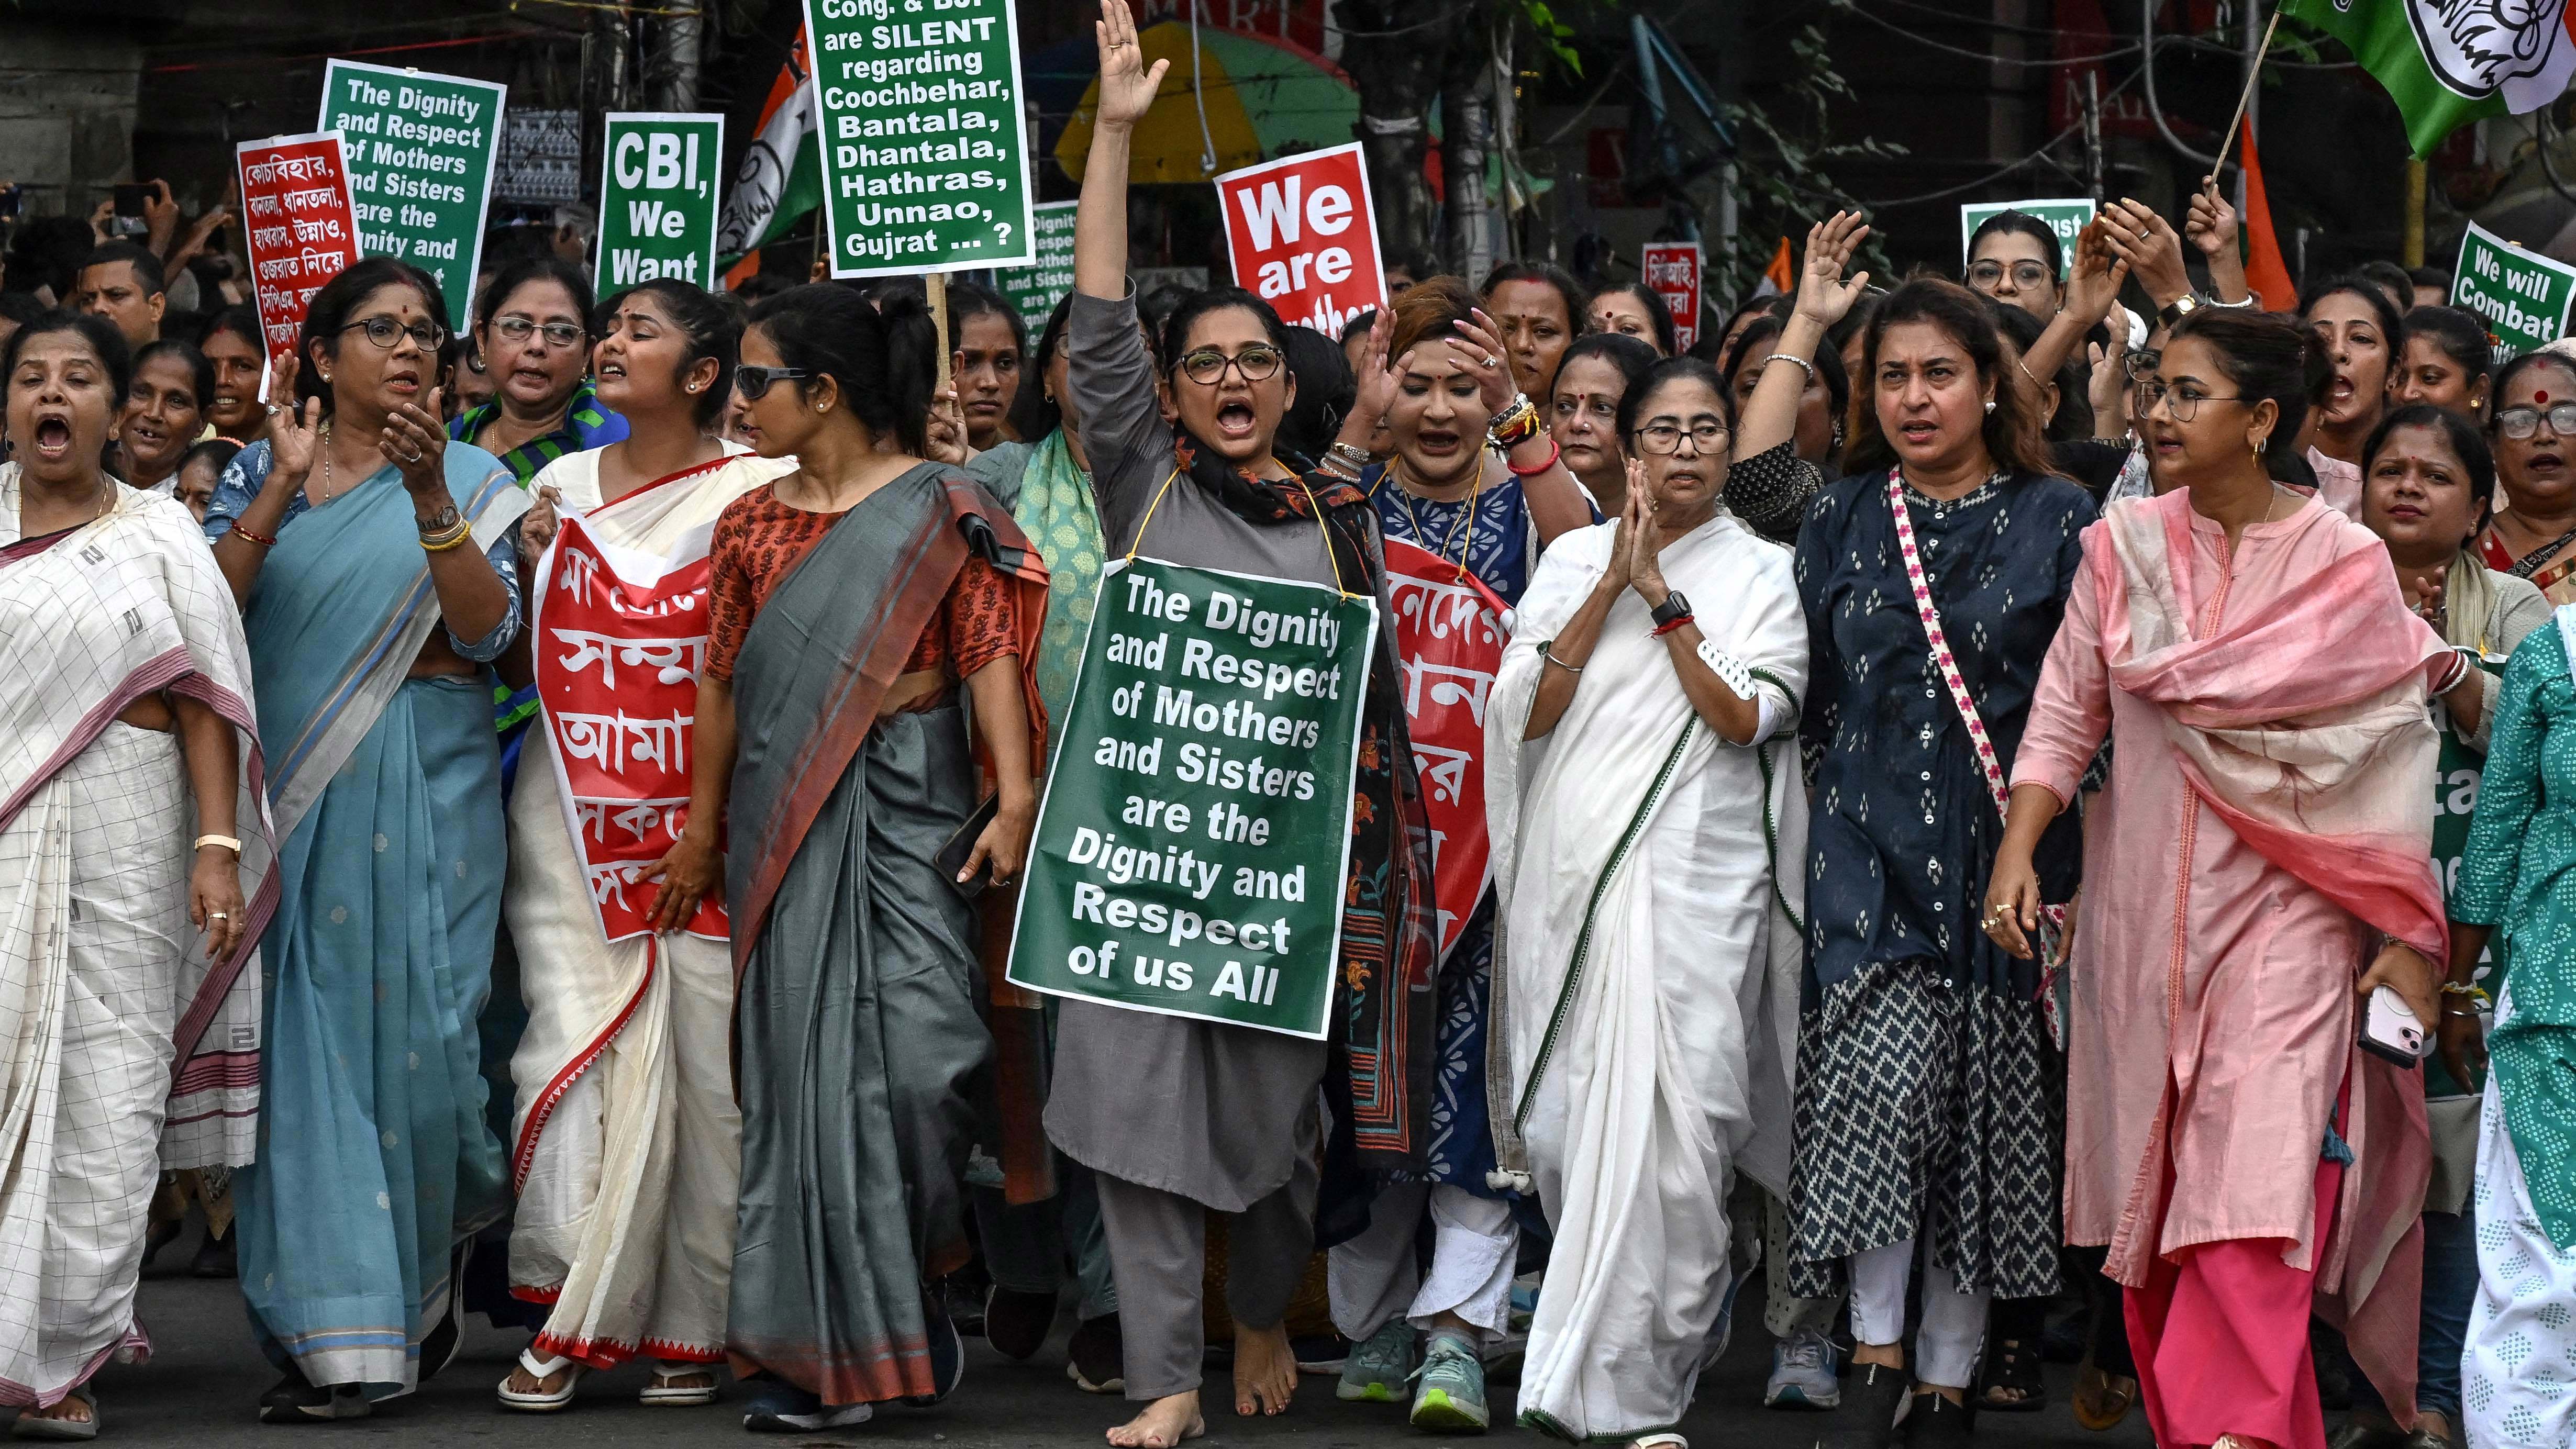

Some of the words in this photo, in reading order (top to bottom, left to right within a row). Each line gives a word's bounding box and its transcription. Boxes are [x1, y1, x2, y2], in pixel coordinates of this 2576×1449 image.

[822, 0, 895, 21] Cong.
[825, 31, 862, 51] are
[872, 17, 996, 50] SILENT
[842, 50, 983, 83] regarding
[348, 79, 391, 106] The
[398, 87, 480, 124] Dignity
[825, 78, 1009, 110] Coochbehar,
[336, 112, 377, 134] and
[386, 114, 481, 148] Respect
[838, 107, 1000, 139] Bantala,
[246, 154, 335, 186] কোচবিহার,
[345, 139, 367, 161] of
[373, 142, 465, 174] Mothers
[615, 132, 707, 199] CBI,
[837, 137, 1006, 169] Dhantala,
[283, 184, 342, 213] ধানতলা,
[350, 170, 377, 192] nd
[385, 172, 464, 203] Sisters
[841, 170, 1007, 198] Hathras,
[357, 203, 393, 224] are
[401, 206, 436, 228] the
[628, 200, 685, 238] We
[857, 202, 992, 226] Unnao,
[1034, 214, 1076, 233] Dignit
[1237, 175, 1353, 252] We
[253, 225, 293, 252] হাথরাস,
[292, 217, 346, 243] উন্নাও,
[360, 231, 408, 259] nity
[414, 239, 457, 260] and
[846, 229, 938, 261] Gujrat
[993, 222, 1012, 246] ?
[1035, 235, 1075, 253] espe
[612, 249, 697, 285] Want
[1007, 275, 1031, 291] and
[1035, 271, 1075, 288] Siste
[1258, 247, 1352, 299] are
[2474, 244, 2500, 282] We
[2507, 269, 2551, 303] will
[1022, 295, 1046, 308] are
[1049, 288, 1065, 305] th
[2459, 276, 2554, 342] Combat
[1127, 574, 1190, 622] The
[1206, 590, 1340, 656] Dignity
[550, 628, 709, 691] সম্ম
[1107, 632, 1165, 671] and
[1181, 638, 1340, 701] Respect
[1112, 682, 1144, 719] of
[1153, 686, 1319, 750] Mothers
[556, 707, 694, 775] আমা
[1095, 737, 1163, 776] and
[1176, 742, 1315, 801] Sisters
[1122, 795, 1191, 834] are
[1207, 802, 1270, 846] the
[1067, 827, 1222, 900] Dignity
[1233, 865, 1306, 902] and
[1072, 881, 1291, 955] Respect
[1068, 941, 1118, 975] of
[1134, 957, 1194, 991] us
[1209, 960, 1279, 1006] All
